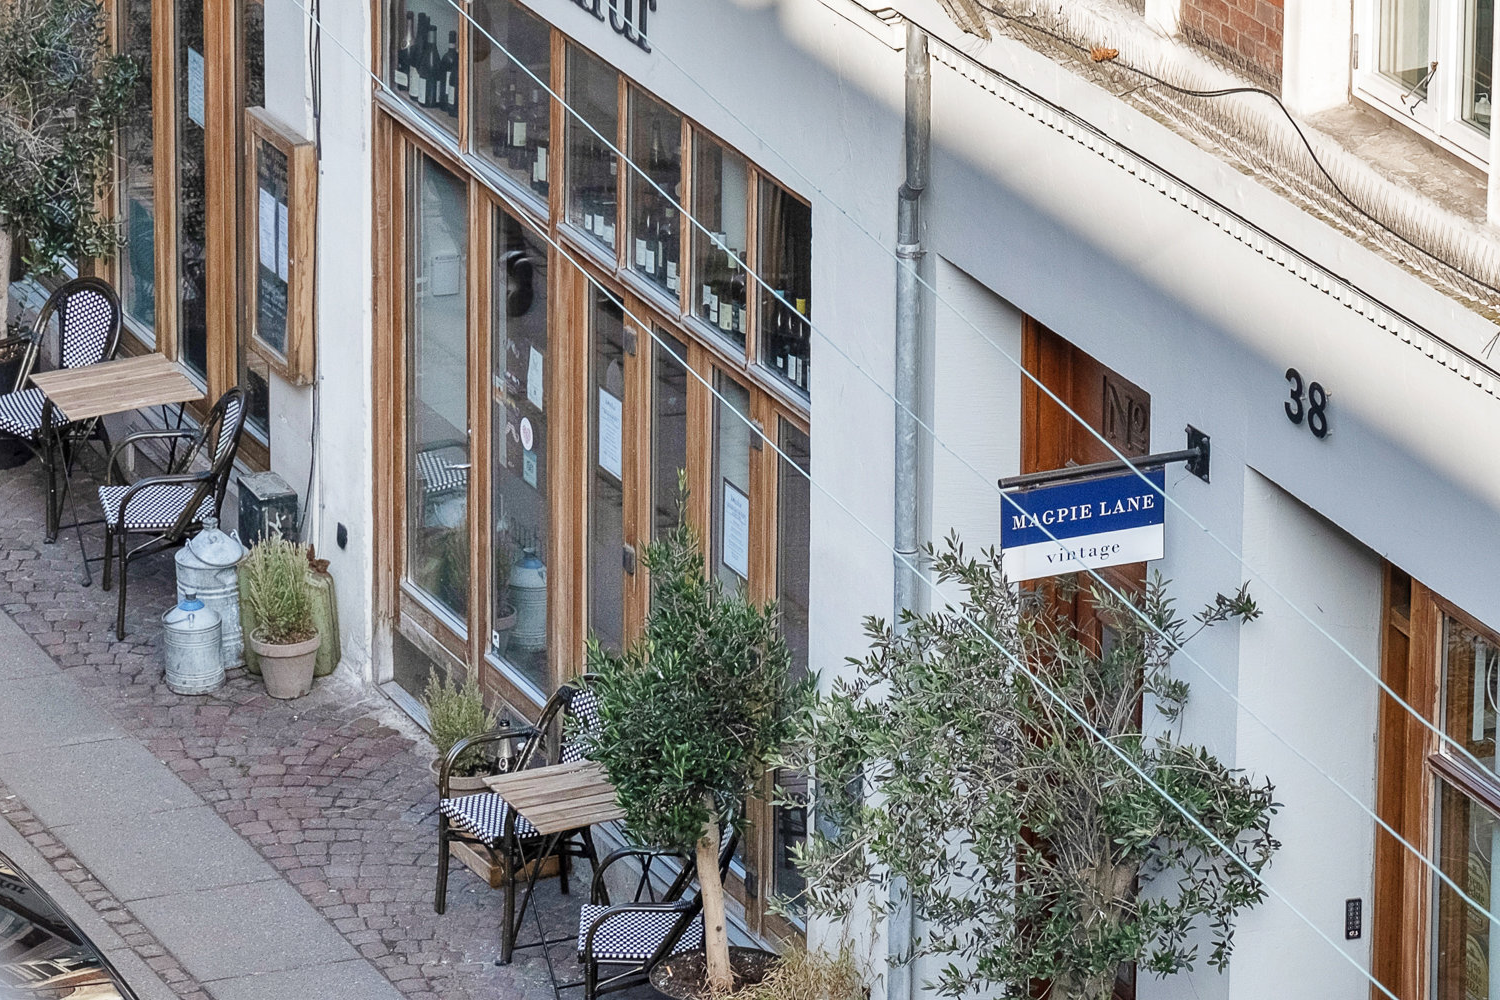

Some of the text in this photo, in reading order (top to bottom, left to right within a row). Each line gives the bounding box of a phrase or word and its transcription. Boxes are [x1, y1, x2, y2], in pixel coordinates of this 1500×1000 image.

[1284, 368, 1327, 438] 38
[1012, 494, 1154, 530] MAGPIE LANE
[1047, 543, 1121, 564] vintage
